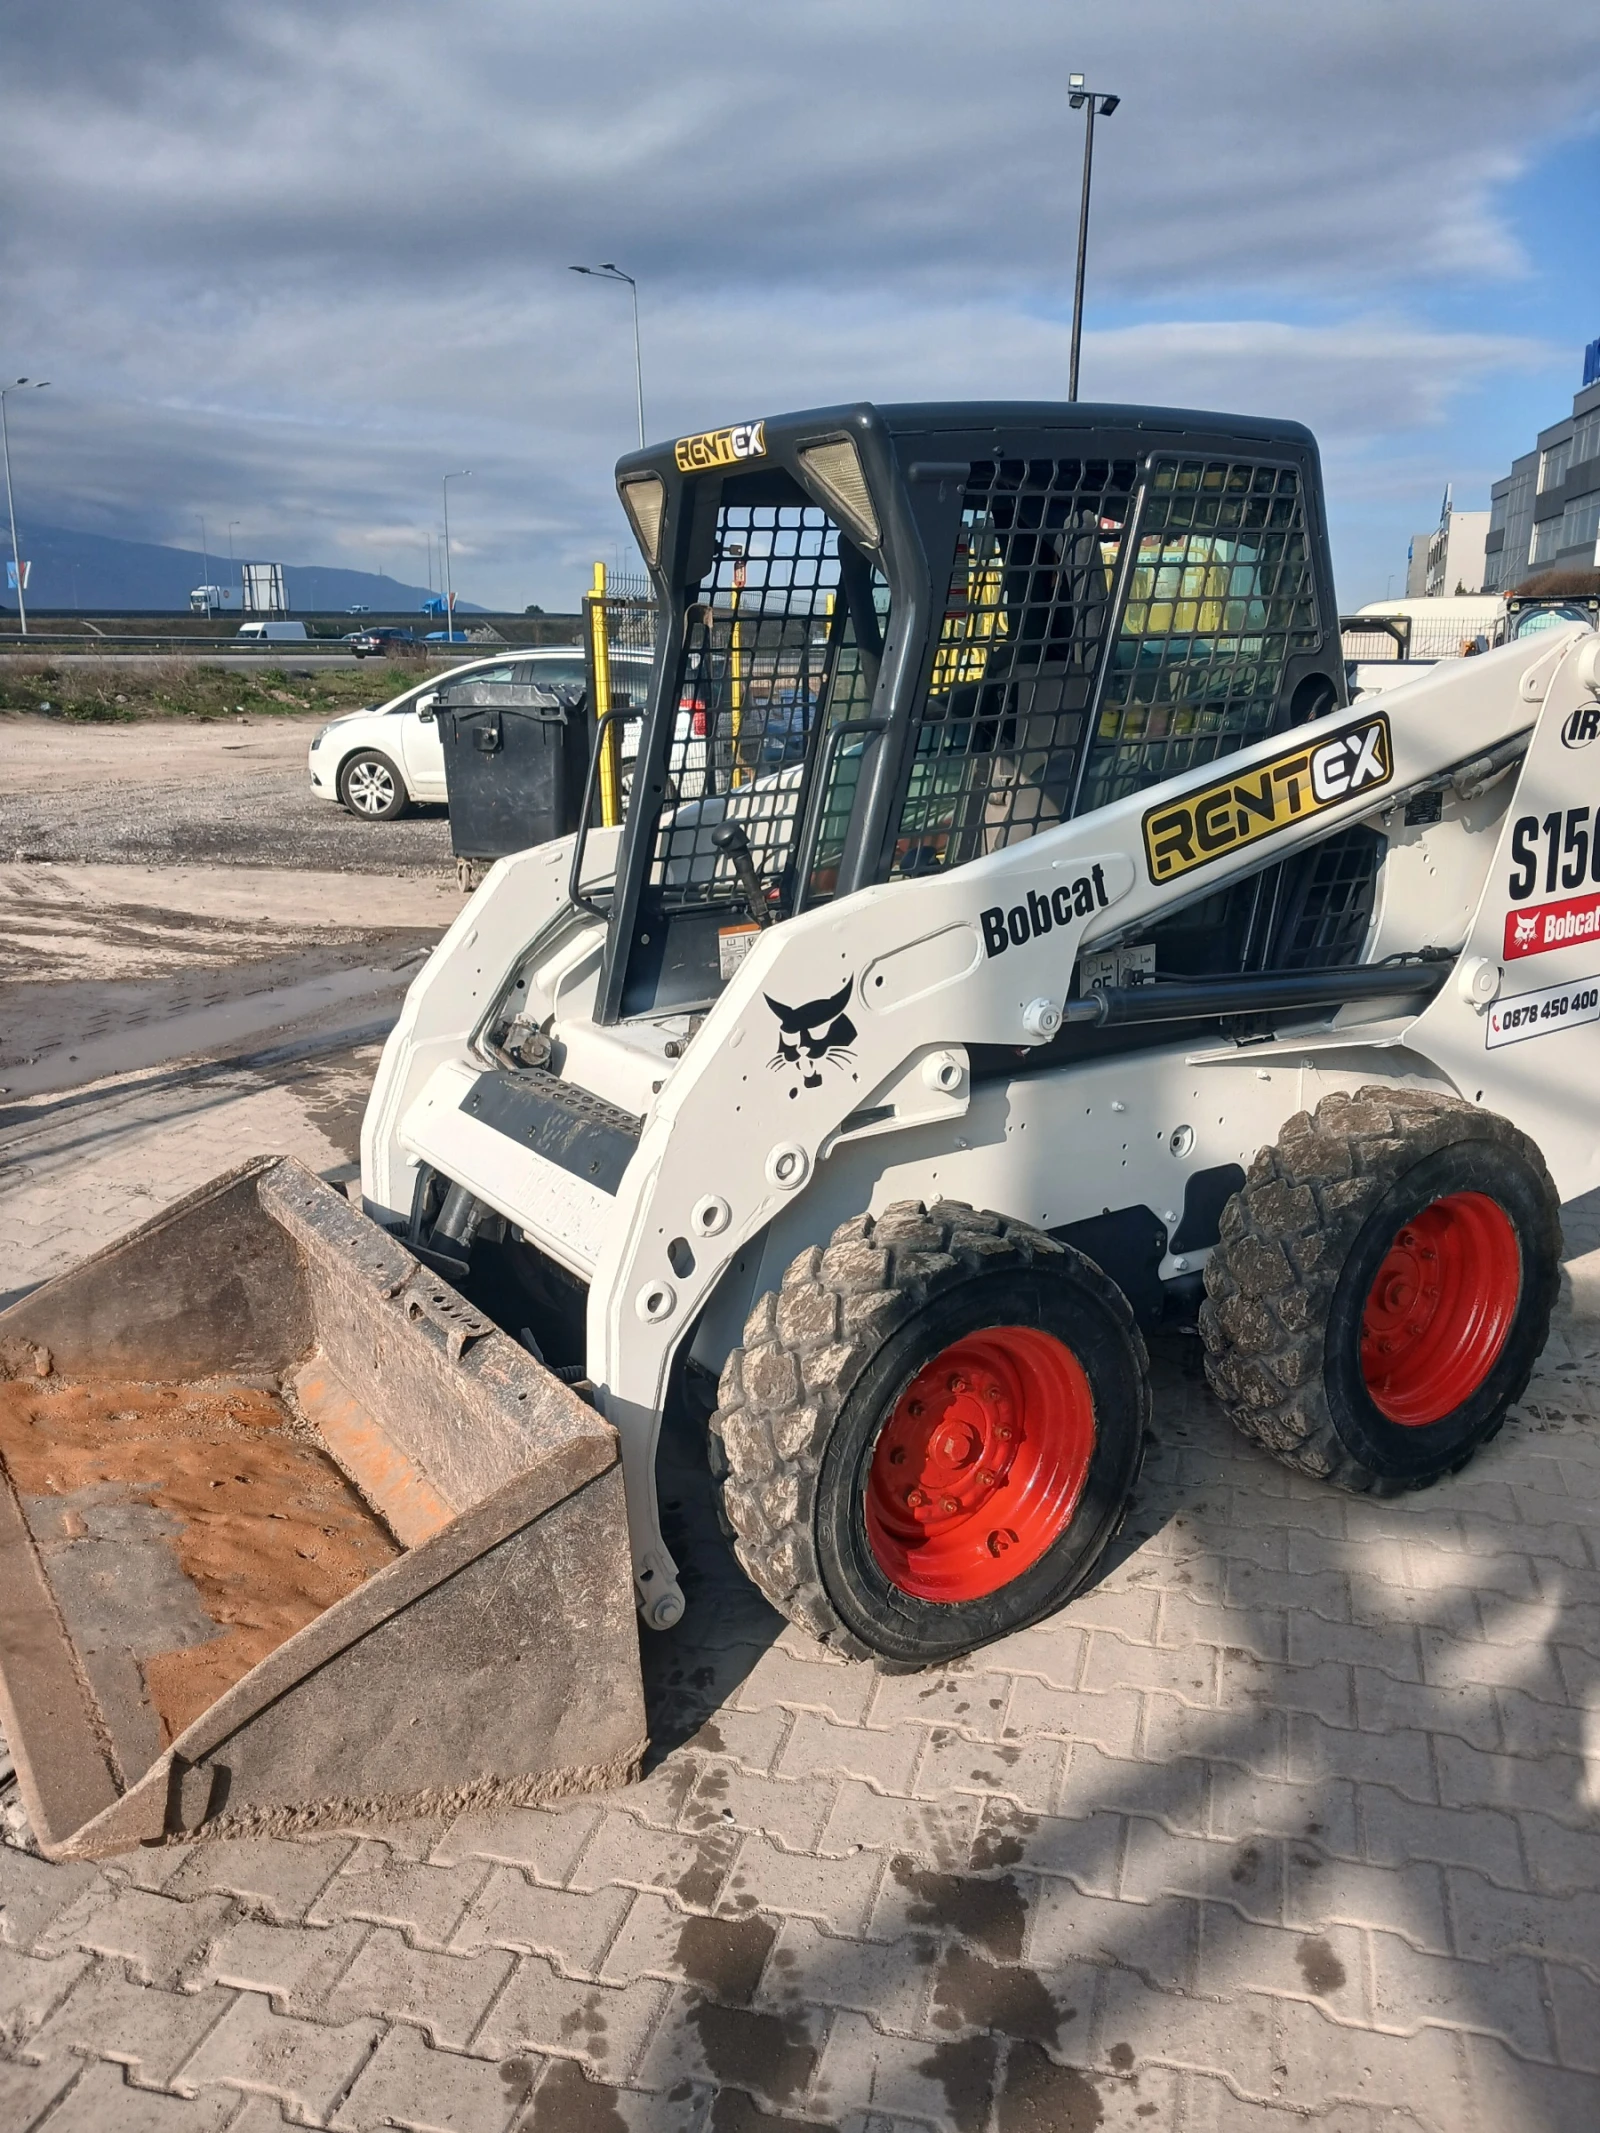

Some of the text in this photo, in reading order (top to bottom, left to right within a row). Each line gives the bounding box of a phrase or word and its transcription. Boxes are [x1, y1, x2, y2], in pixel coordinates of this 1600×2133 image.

[677, 423, 763, 468] RENTEX
[1150, 725, 1386, 875] RENTEX
[979, 863, 1109, 959] Bobcat
[1503, 989, 1598, 1030] 0878 450 400
